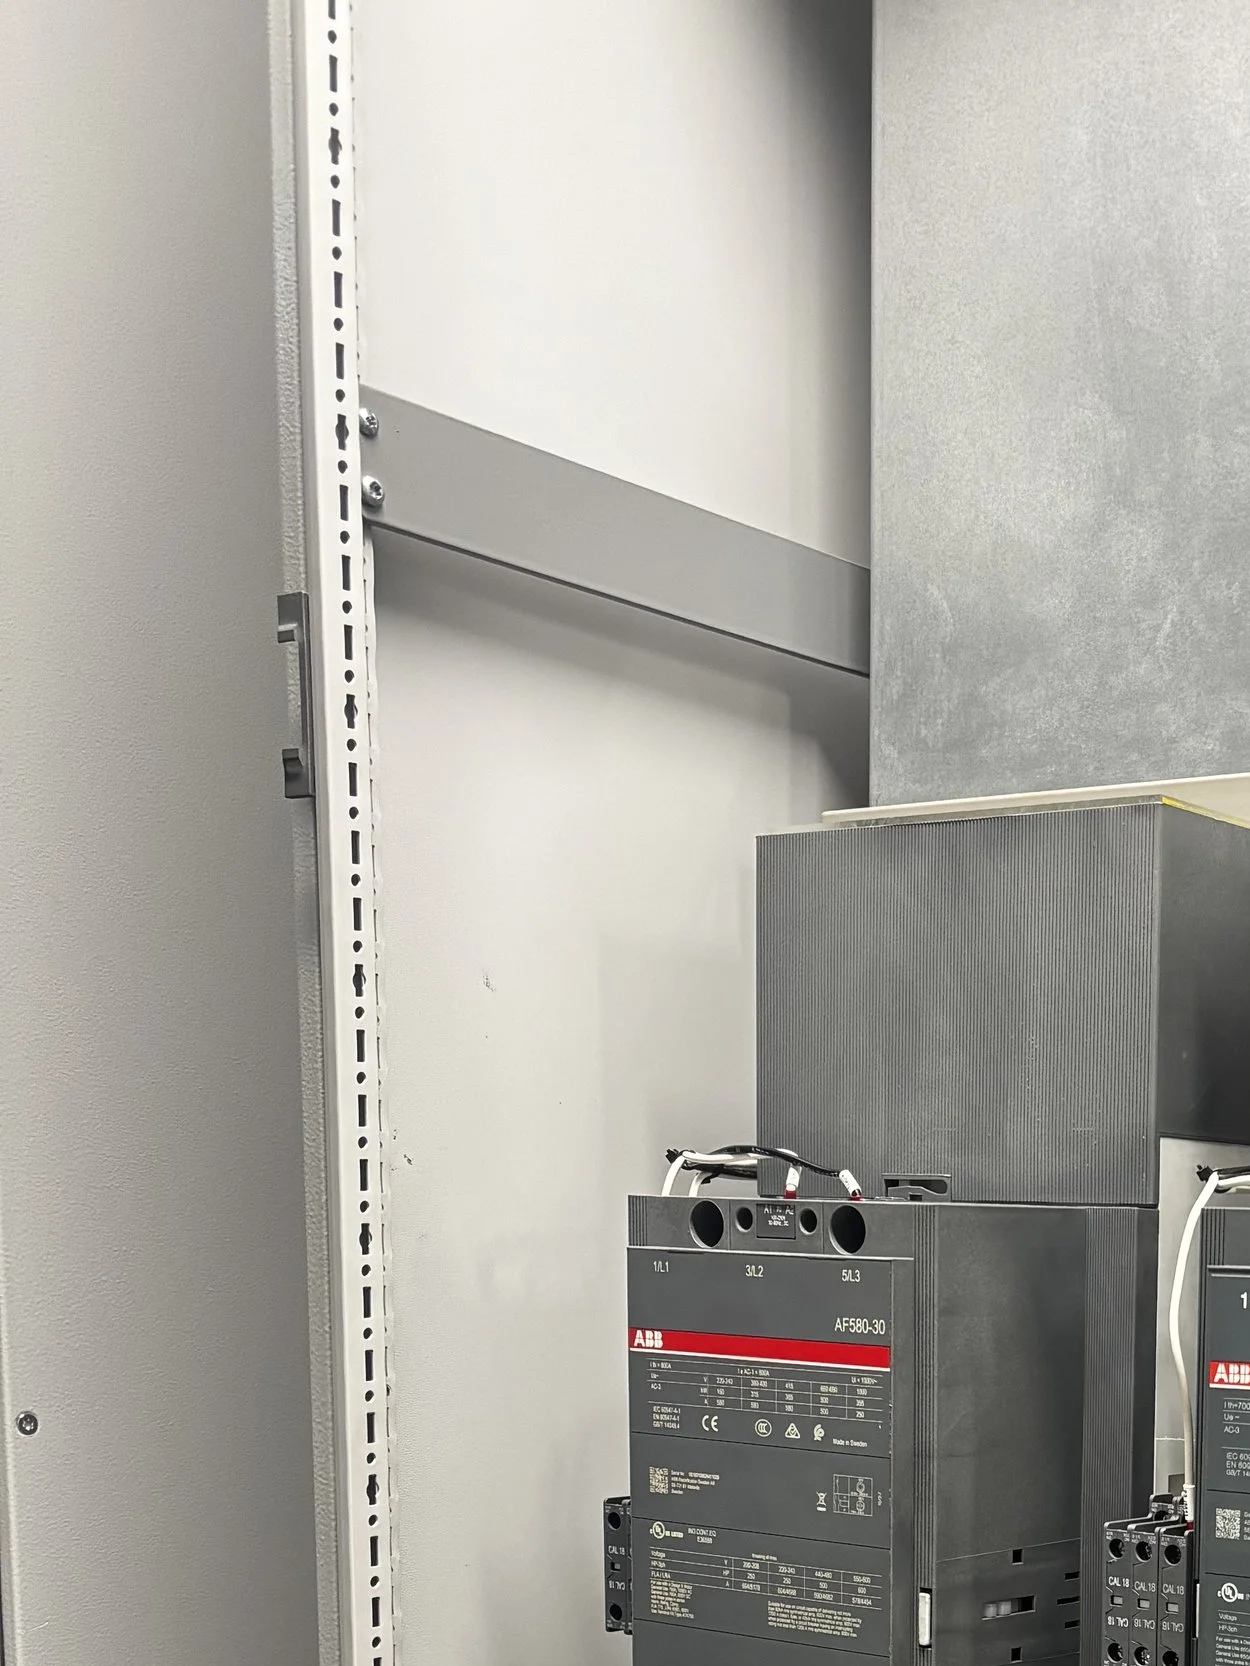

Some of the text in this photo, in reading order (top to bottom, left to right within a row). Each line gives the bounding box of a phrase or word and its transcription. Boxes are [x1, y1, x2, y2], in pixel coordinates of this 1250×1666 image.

[653, 1260, 669, 1273] 1/L1
[745, 1264, 764, 1278] 3/L2
[841, 1269, 861, 1283] 5/L3
[834, 1317, 886, 1335] AF580-30
[633, 1329, 664, 1349] ABB
[1213, 1363, 1250, 1384] ABB
[1224, 1426, 1240, 1434] AC-3
[1226, 1461, 1236, 1469] EN
[1108, 1576, 1121, 1586] CAL
[1134, 1580, 1147, 1591] CAL
[1162, 1583, 1176, 1594] CAL
[1115, 1617, 1129, 1628] CAL
[1142, 1618, 1156, 1629] CAL
[1170, 1622, 1184, 1633] CAL
